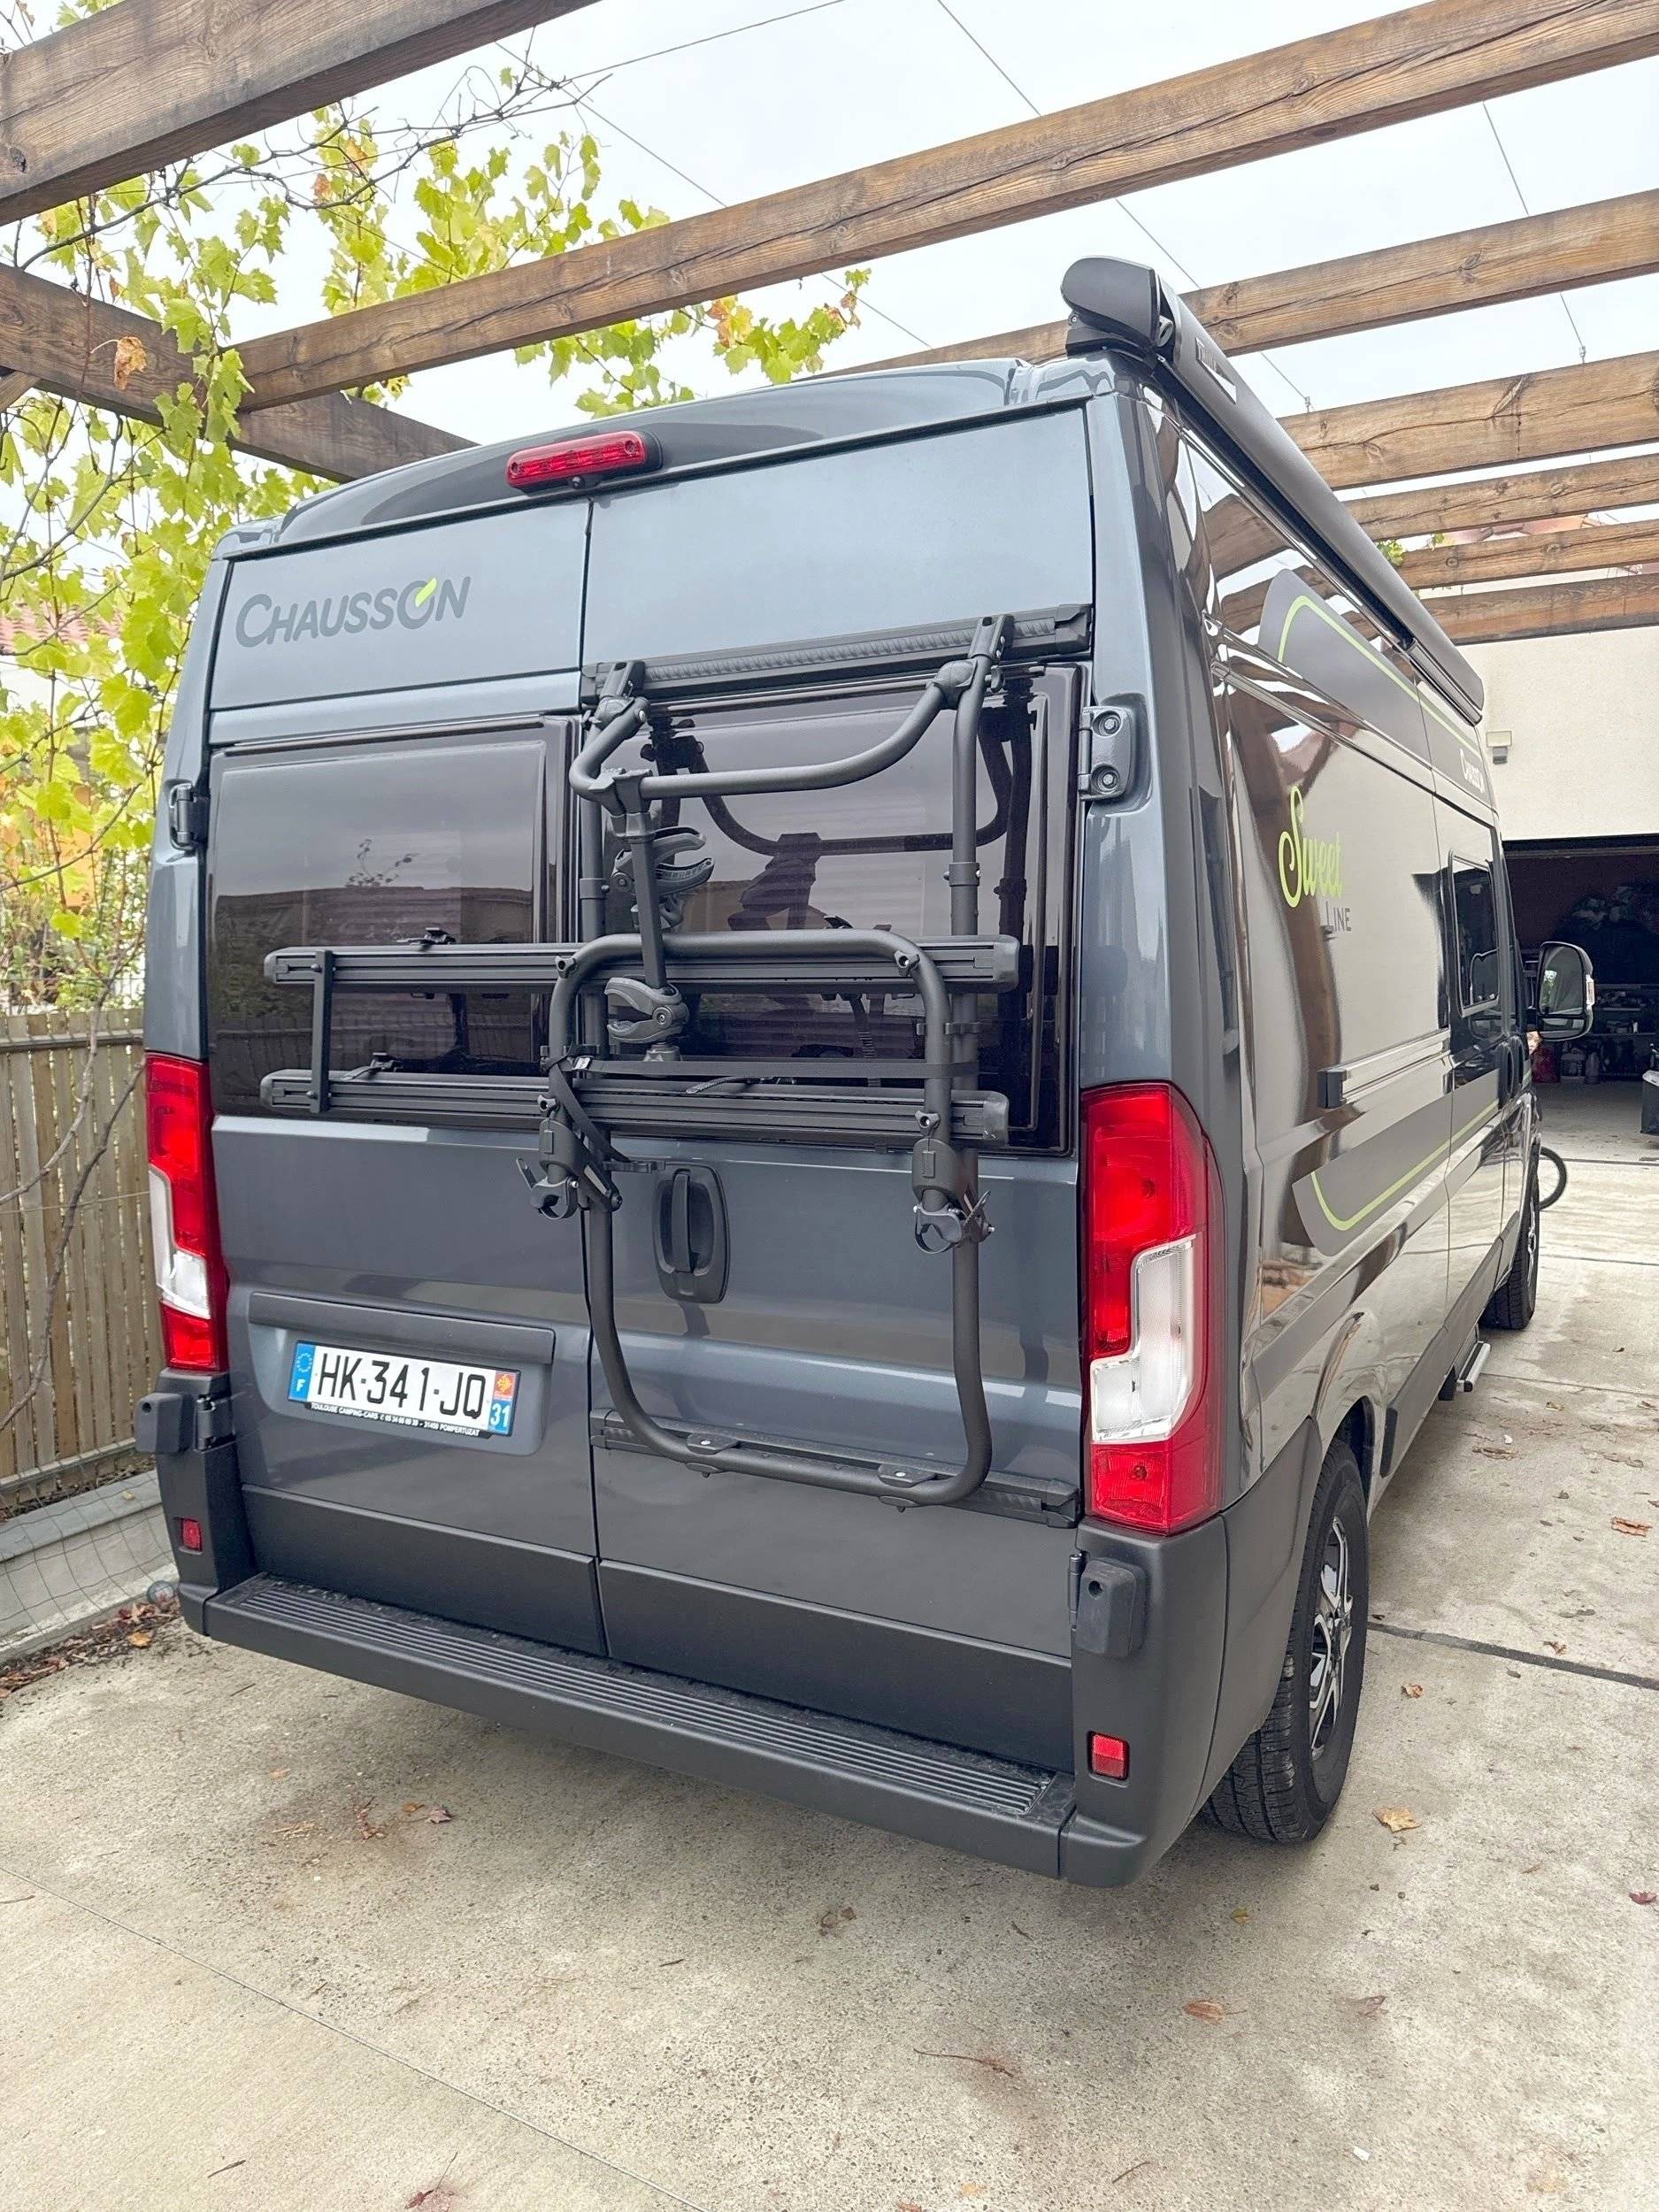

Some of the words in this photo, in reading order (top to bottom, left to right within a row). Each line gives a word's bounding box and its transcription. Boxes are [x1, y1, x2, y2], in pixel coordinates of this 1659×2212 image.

[235, 576, 471, 648] CHAUSSON
[1279, 786, 1343, 908] Sweet
[296, 1379, 306, 1392] F
[490, 1402, 511, 1427] 31
